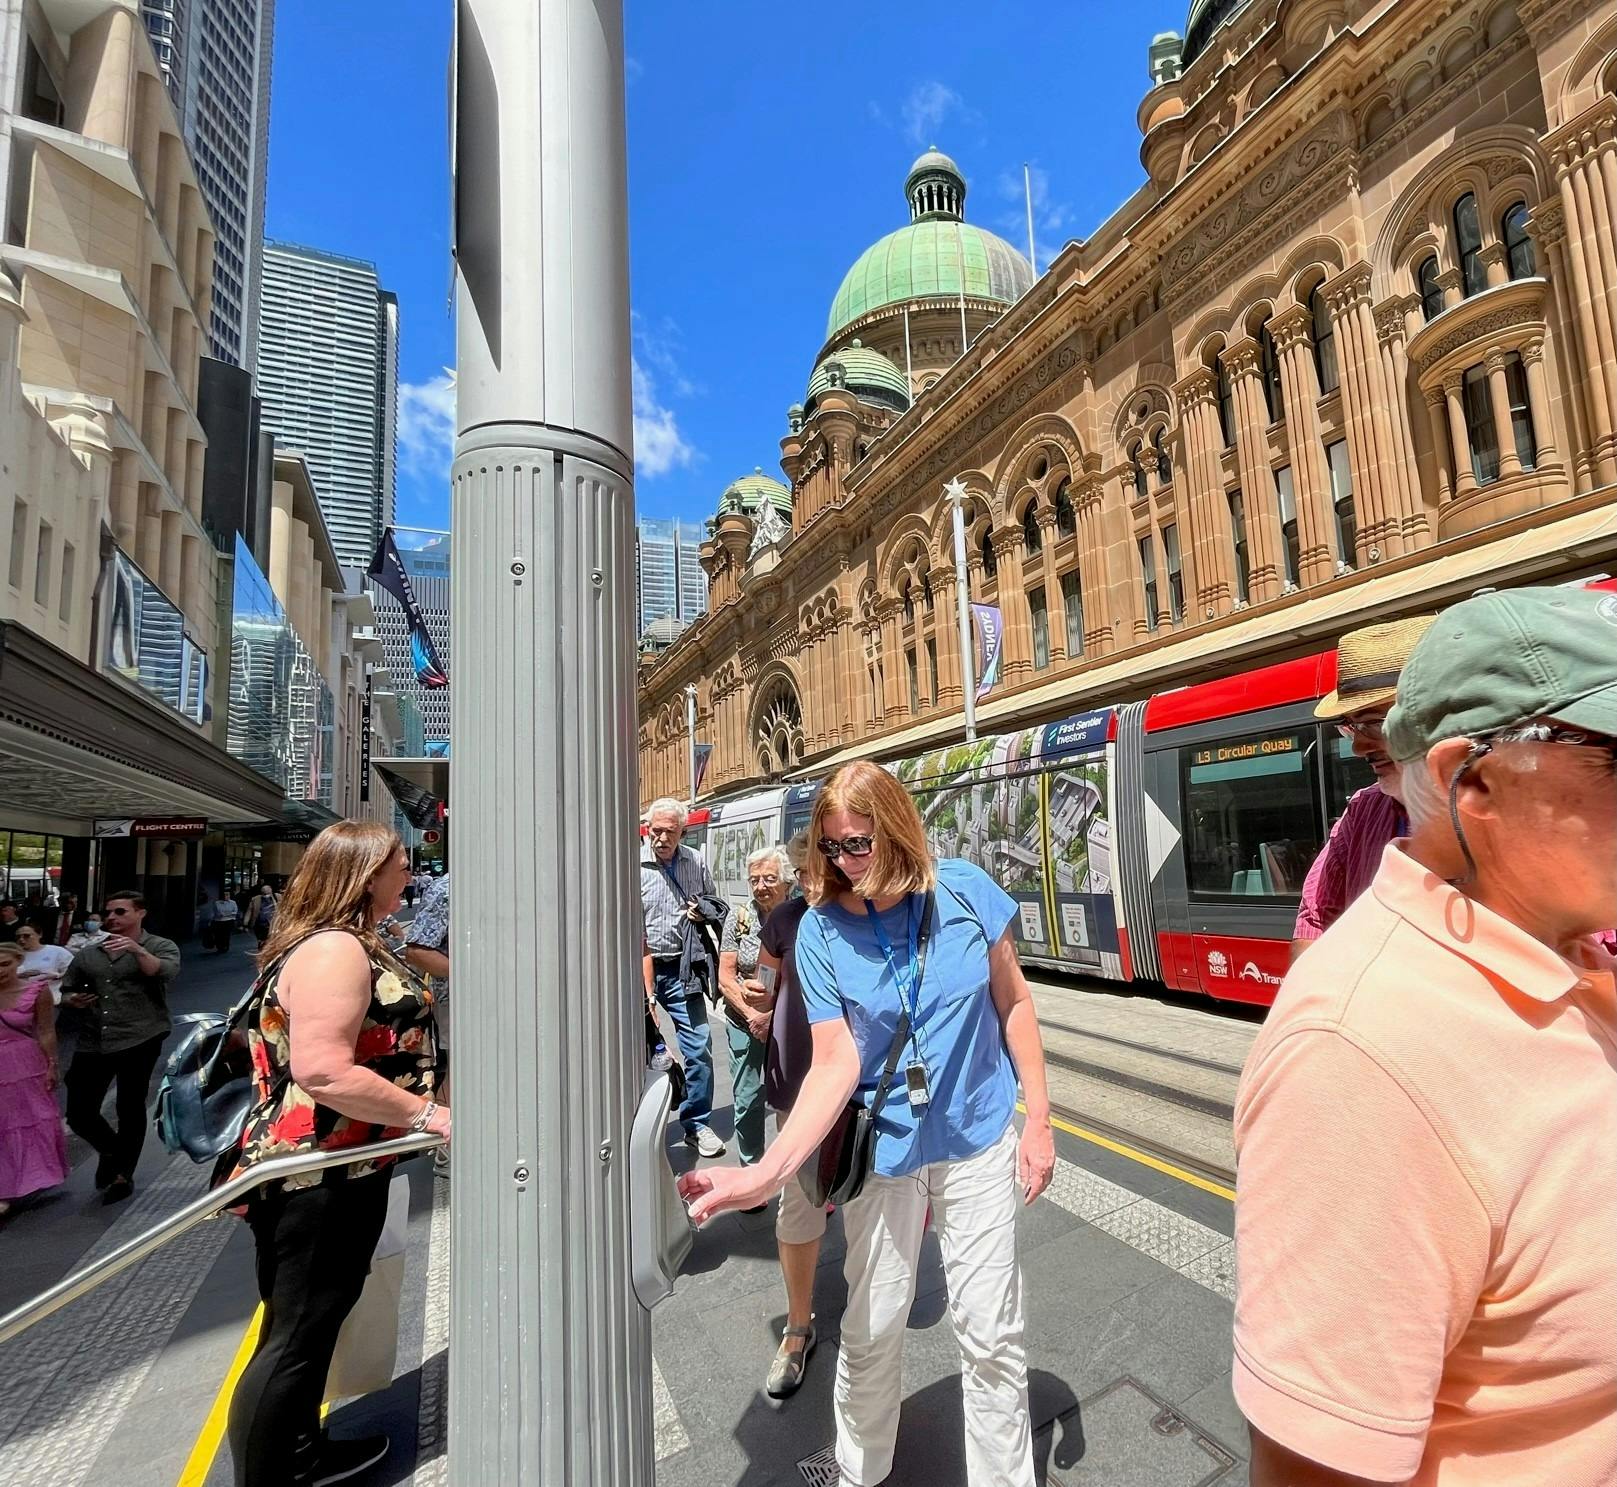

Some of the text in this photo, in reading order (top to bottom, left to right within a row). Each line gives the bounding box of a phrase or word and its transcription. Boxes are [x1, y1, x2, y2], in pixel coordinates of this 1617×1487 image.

[1058, 716, 1103, 734] First Sentier
[1056, 731, 1086, 745] Investors
[362, 716, 370, 787] GALERIES
[1197, 738, 1292, 763] L3 Circular Quay
[1209, 965, 1228, 975] NSW
